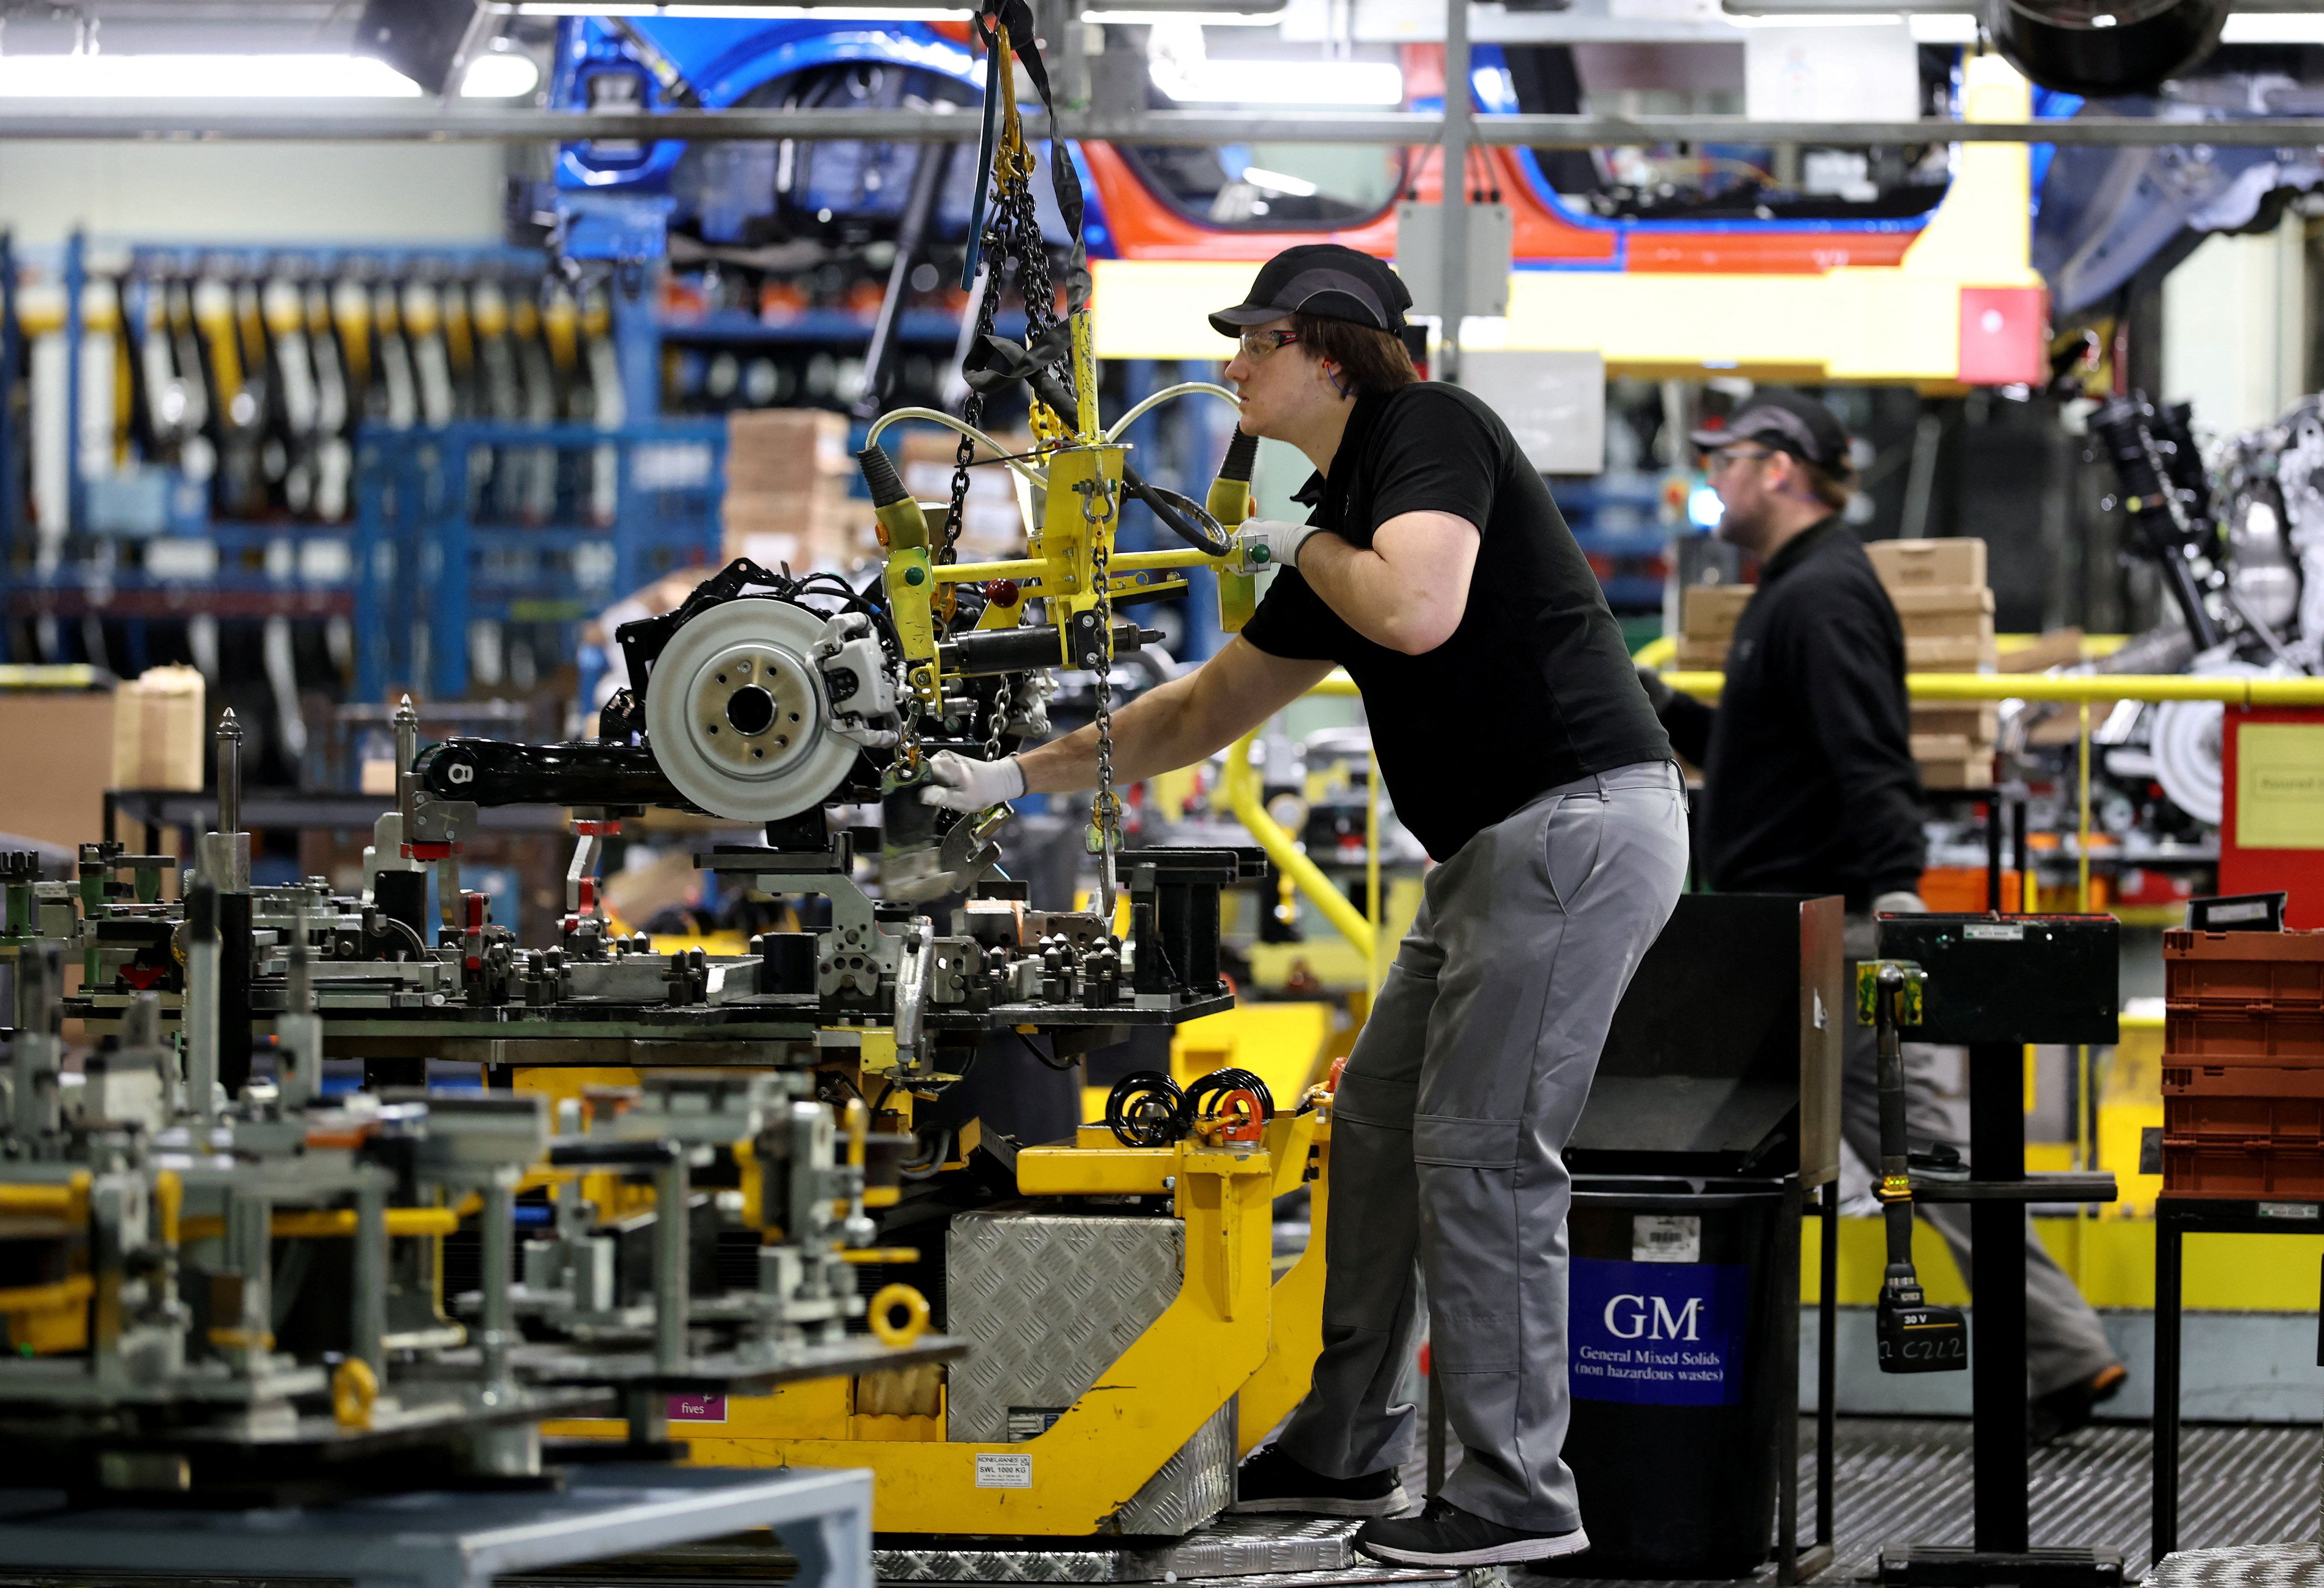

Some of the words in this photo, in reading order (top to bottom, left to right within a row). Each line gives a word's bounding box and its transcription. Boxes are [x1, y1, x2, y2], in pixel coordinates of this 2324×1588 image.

[1603, 1294, 1703, 1341] GM
[1919, 1314, 1927, 1323] V
[1579, 1346, 1631, 1363] General
[1635, 1350, 1678, 1365] Mixed
[1682, 1352, 1720, 1365] Solids
[1574, 1362, 1603, 1377] (non
[1607, 1364, 1674, 1380] hazardous
[1678, 1369, 1723, 1382] wastes)
[681, 1402, 705, 1414] fives
